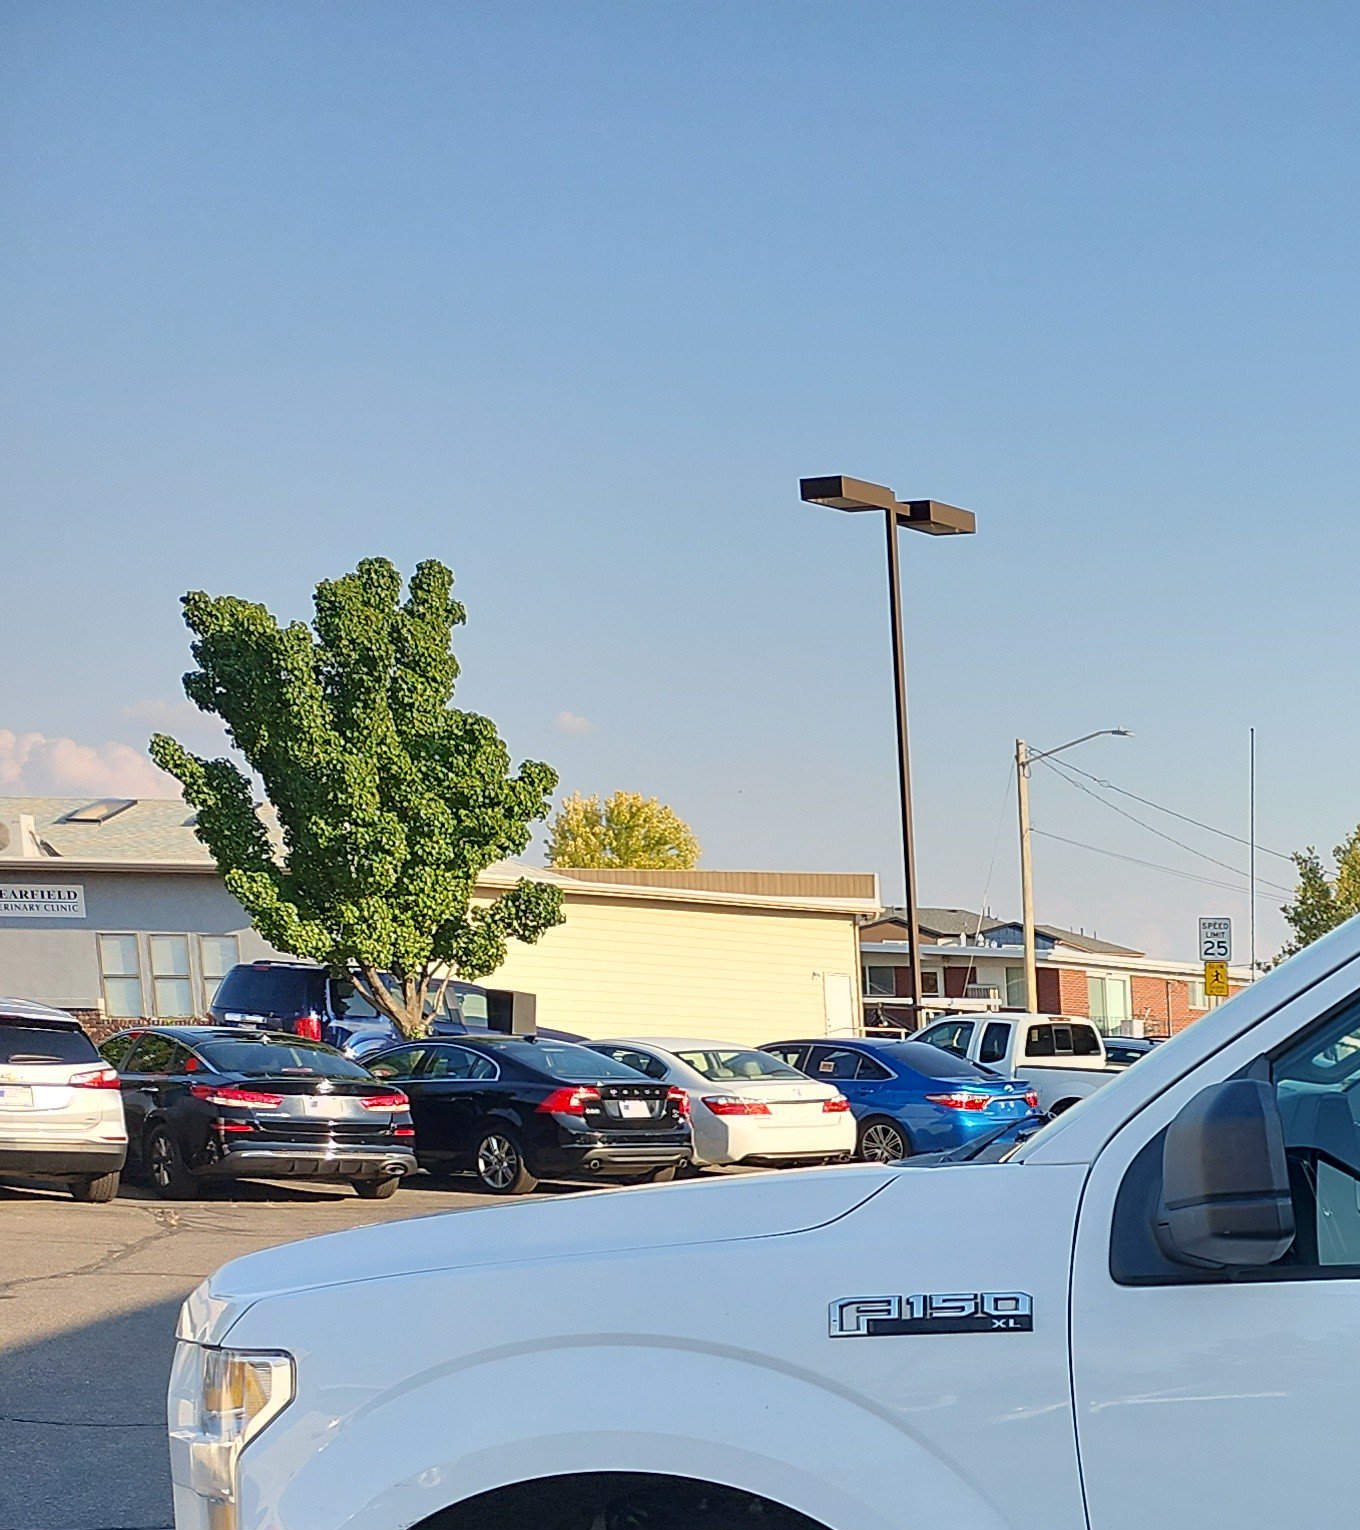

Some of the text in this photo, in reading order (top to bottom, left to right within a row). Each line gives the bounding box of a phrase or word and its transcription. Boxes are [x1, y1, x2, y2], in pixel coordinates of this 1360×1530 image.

[43, 903, 79, 913] CLINIC
[1202, 922, 1229, 930] SPEED
[1203, 940, 1228, 956] 25
[991, 1318, 1022, 1329] XL
